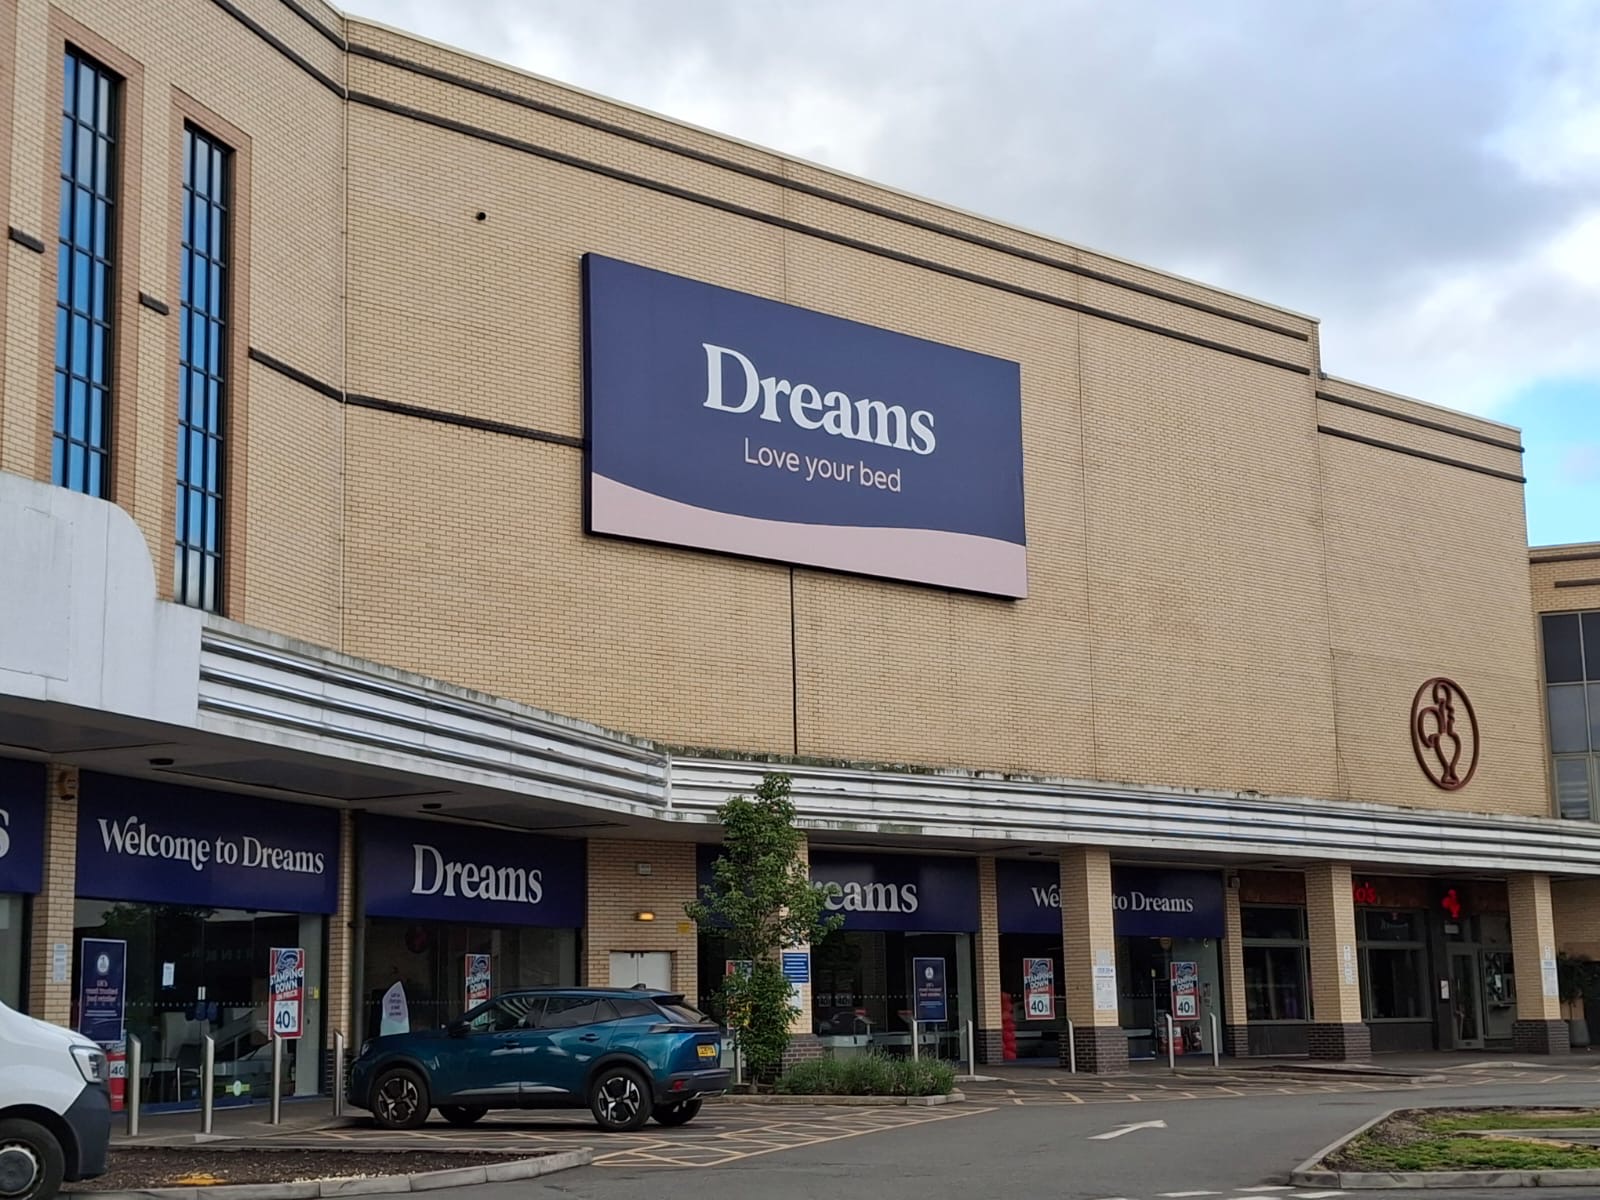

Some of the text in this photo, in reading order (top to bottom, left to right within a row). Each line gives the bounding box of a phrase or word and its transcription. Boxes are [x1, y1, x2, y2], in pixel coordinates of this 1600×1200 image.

[702, 342, 936, 456] Dreams
[744, 437, 902, 494] Love your bed
[97, 815, 325, 875] Welcome to Dreams
[411, 843, 543, 904] Dreams
[809, 881, 919, 914] eams
[1112, 893, 1128, 911] to
[1130, 891, 1194, 913] Dreams
[275, 979, 298, 994] DOWN
